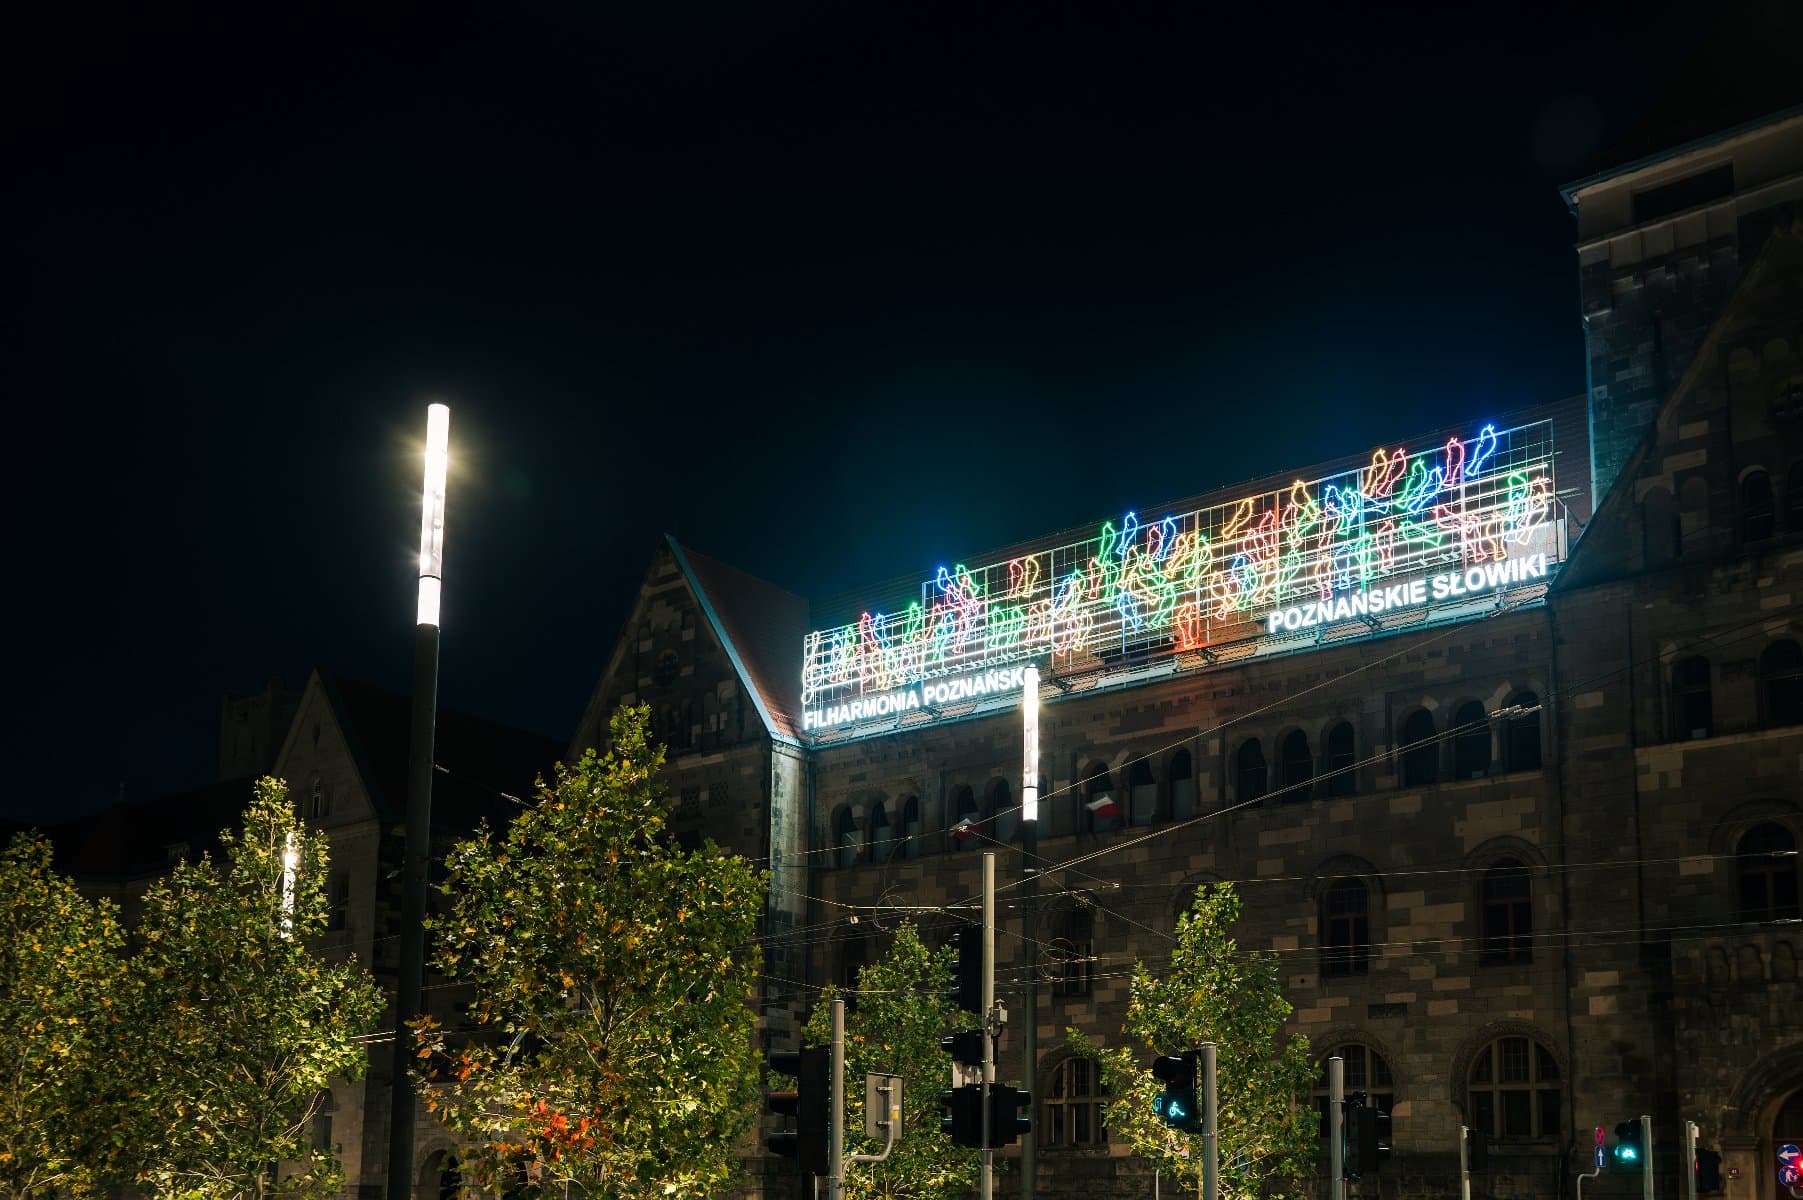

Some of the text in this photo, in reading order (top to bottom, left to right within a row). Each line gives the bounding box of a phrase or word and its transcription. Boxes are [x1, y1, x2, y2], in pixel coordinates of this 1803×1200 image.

[1268, 553, 1548, 633] POZNAŃSKIE SŁOWIKI
[804, 690, 919, 729] FILHARMONIA
